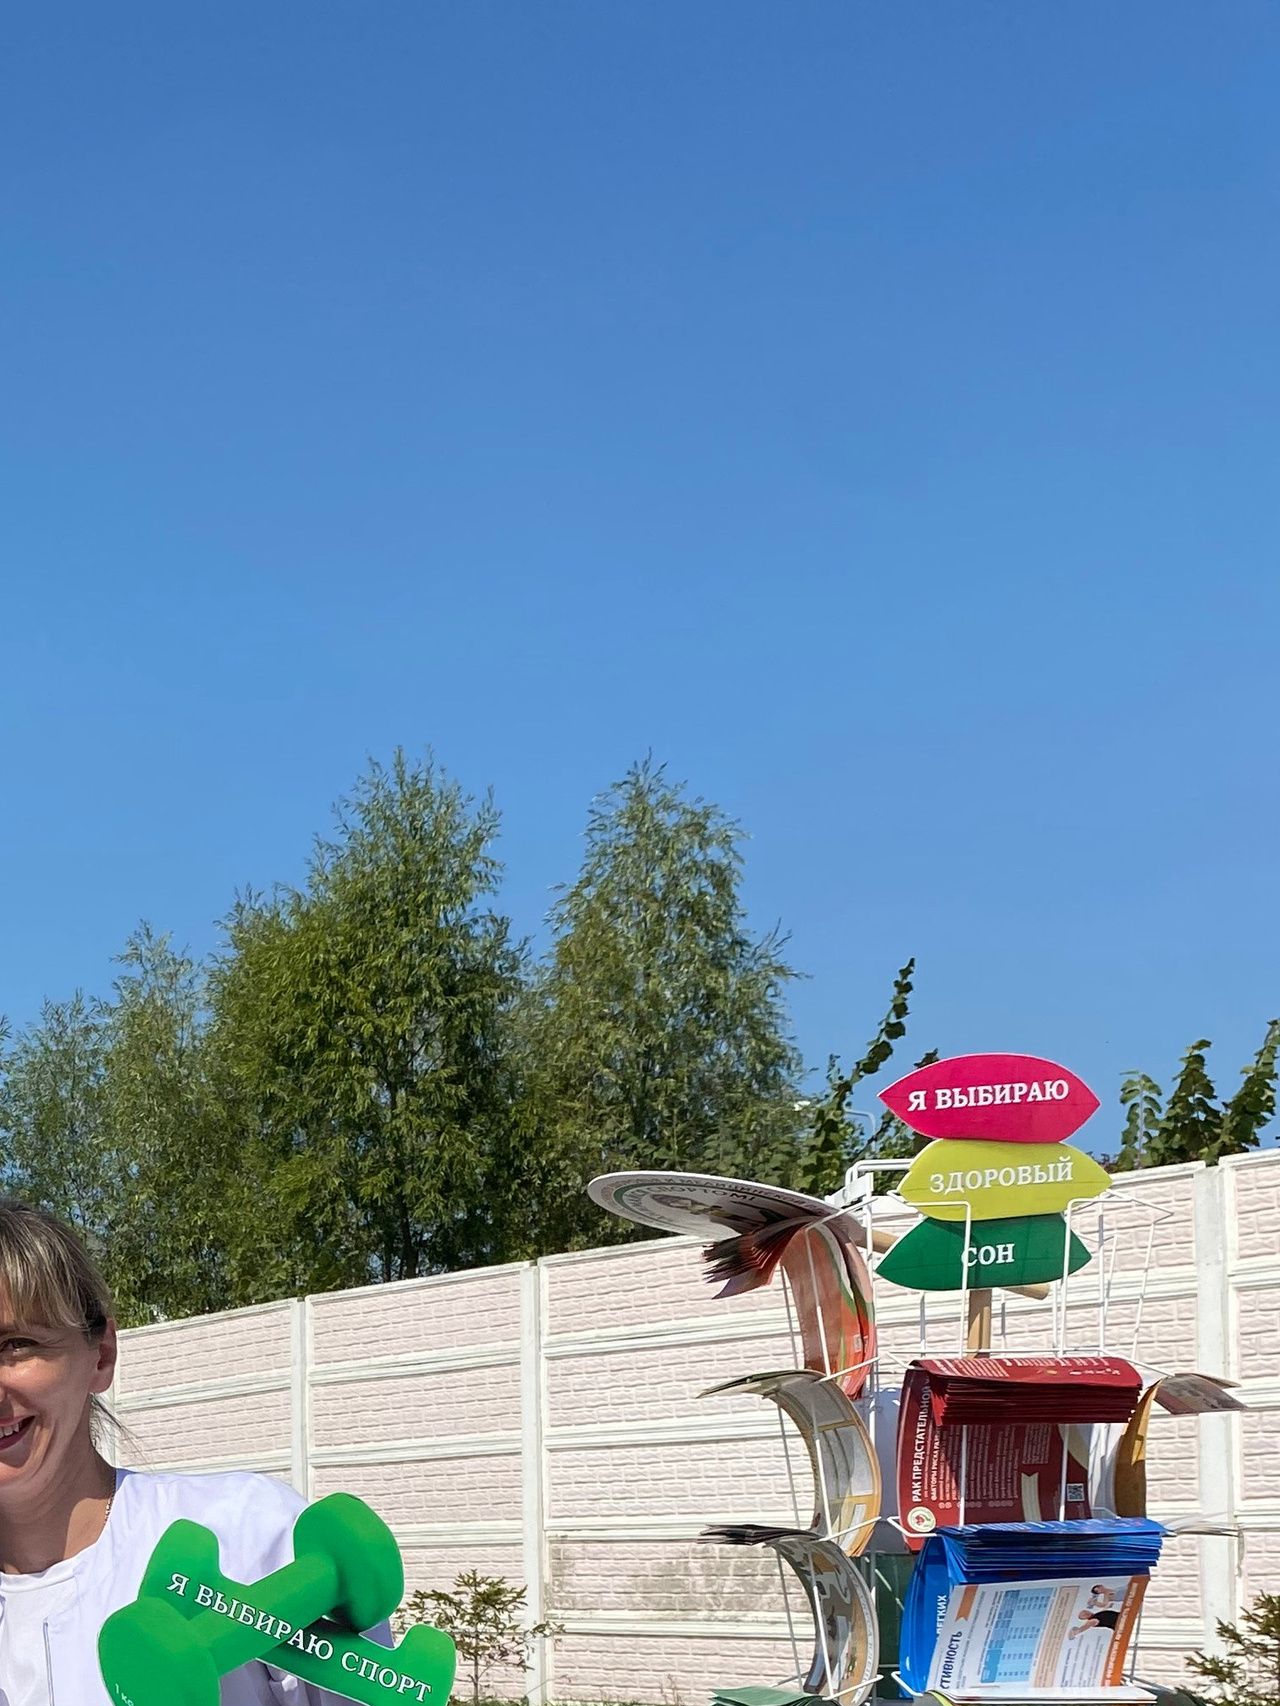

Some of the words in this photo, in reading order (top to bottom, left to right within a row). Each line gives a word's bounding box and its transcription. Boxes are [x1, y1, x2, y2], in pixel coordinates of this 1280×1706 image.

[907, 1090, 927, 1112] Я
[934, 1079, 1069, 1110] ВЫБИРАЮ
[929, 1156, 1074, 1195] ЗДОРОВЫЙ
[961, 1243, 1015, 1267] СОН
[912, 1386, 932, 1479] ПРЕДСТАТЕЛЬНОЙ
[912, 1482, 922, 1502] РАК
[166, 1572, 190, 1597] Я
[194, 1584, 334, 1661] ВЫБИРАЮ
[341, 1652, 432, 1703] СПОРТ
